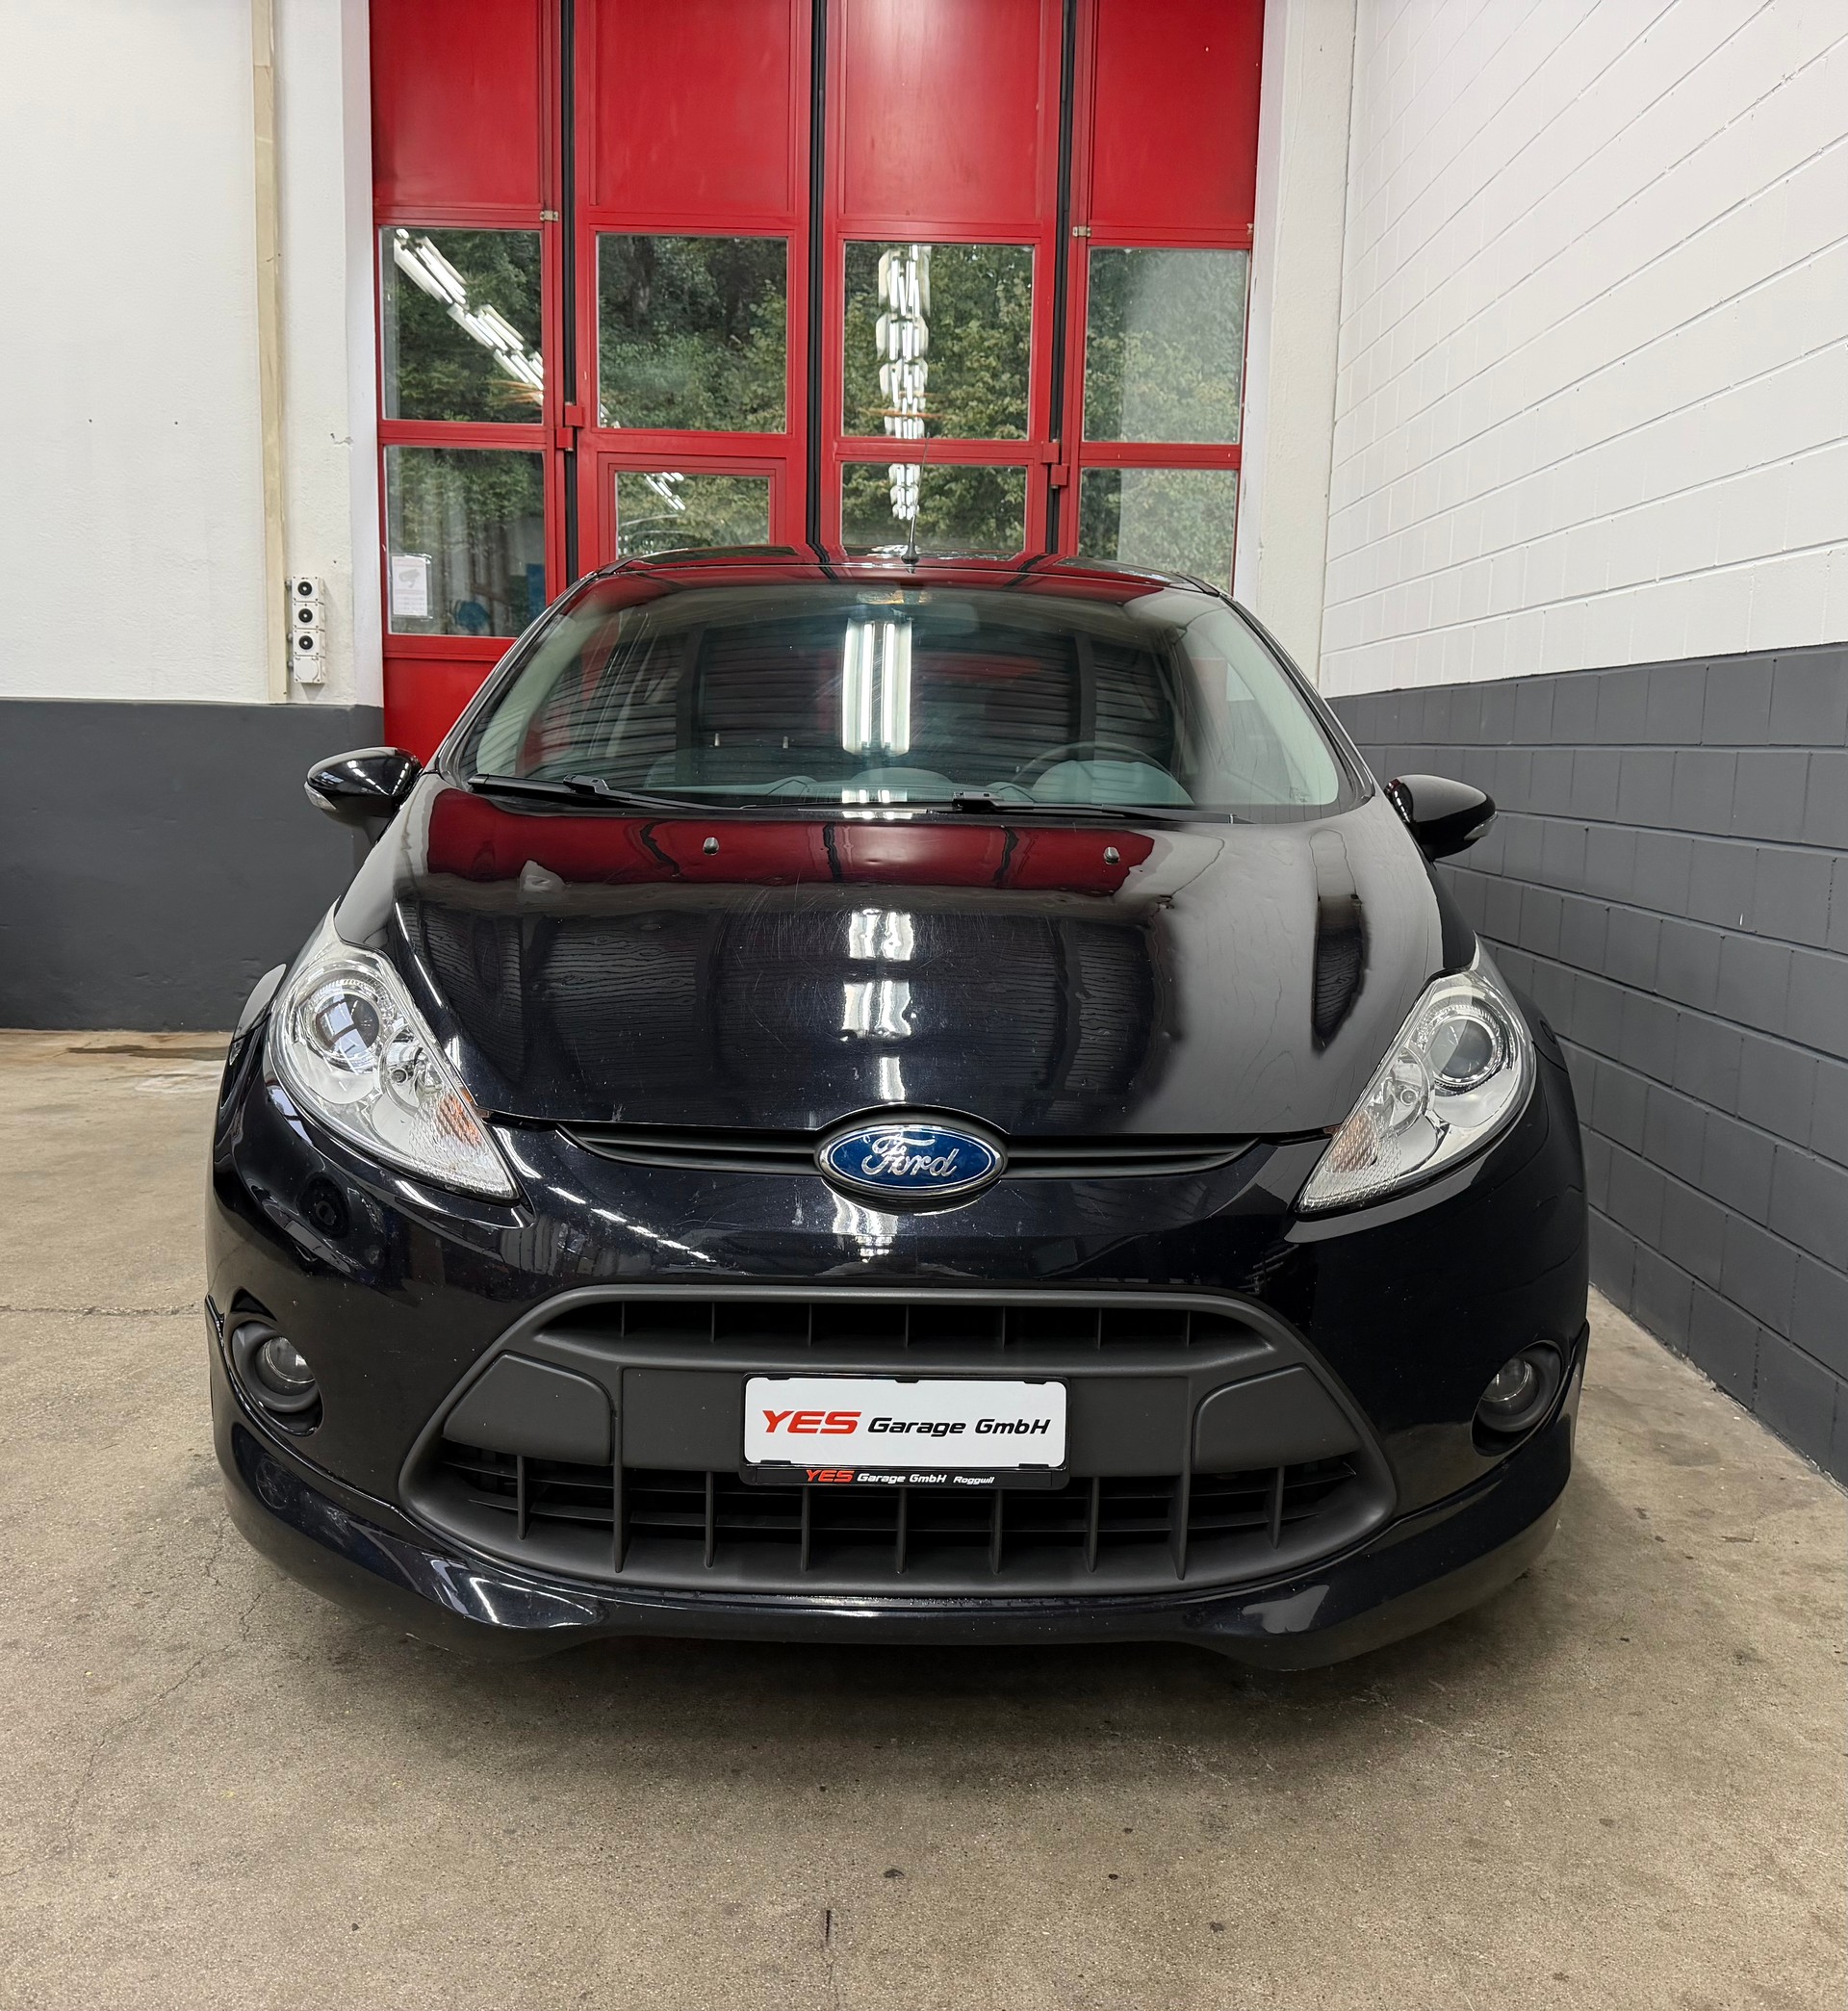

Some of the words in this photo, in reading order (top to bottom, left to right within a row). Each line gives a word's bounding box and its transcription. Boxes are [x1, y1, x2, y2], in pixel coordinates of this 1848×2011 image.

[860, 1134, 960, 1177] Ford
[762, 1410, 862, 1434] YES
[867, 1417, 966, 1437] Garage
[975, 1418, 1052, 1435] GmbH
[806, 1469, 855, 1482] YES
[857, 1473, 905, 1484] Garage
[909, 1474, 947, 1483] GmbH
[953, 1476, 995, 1485] Roggwil
